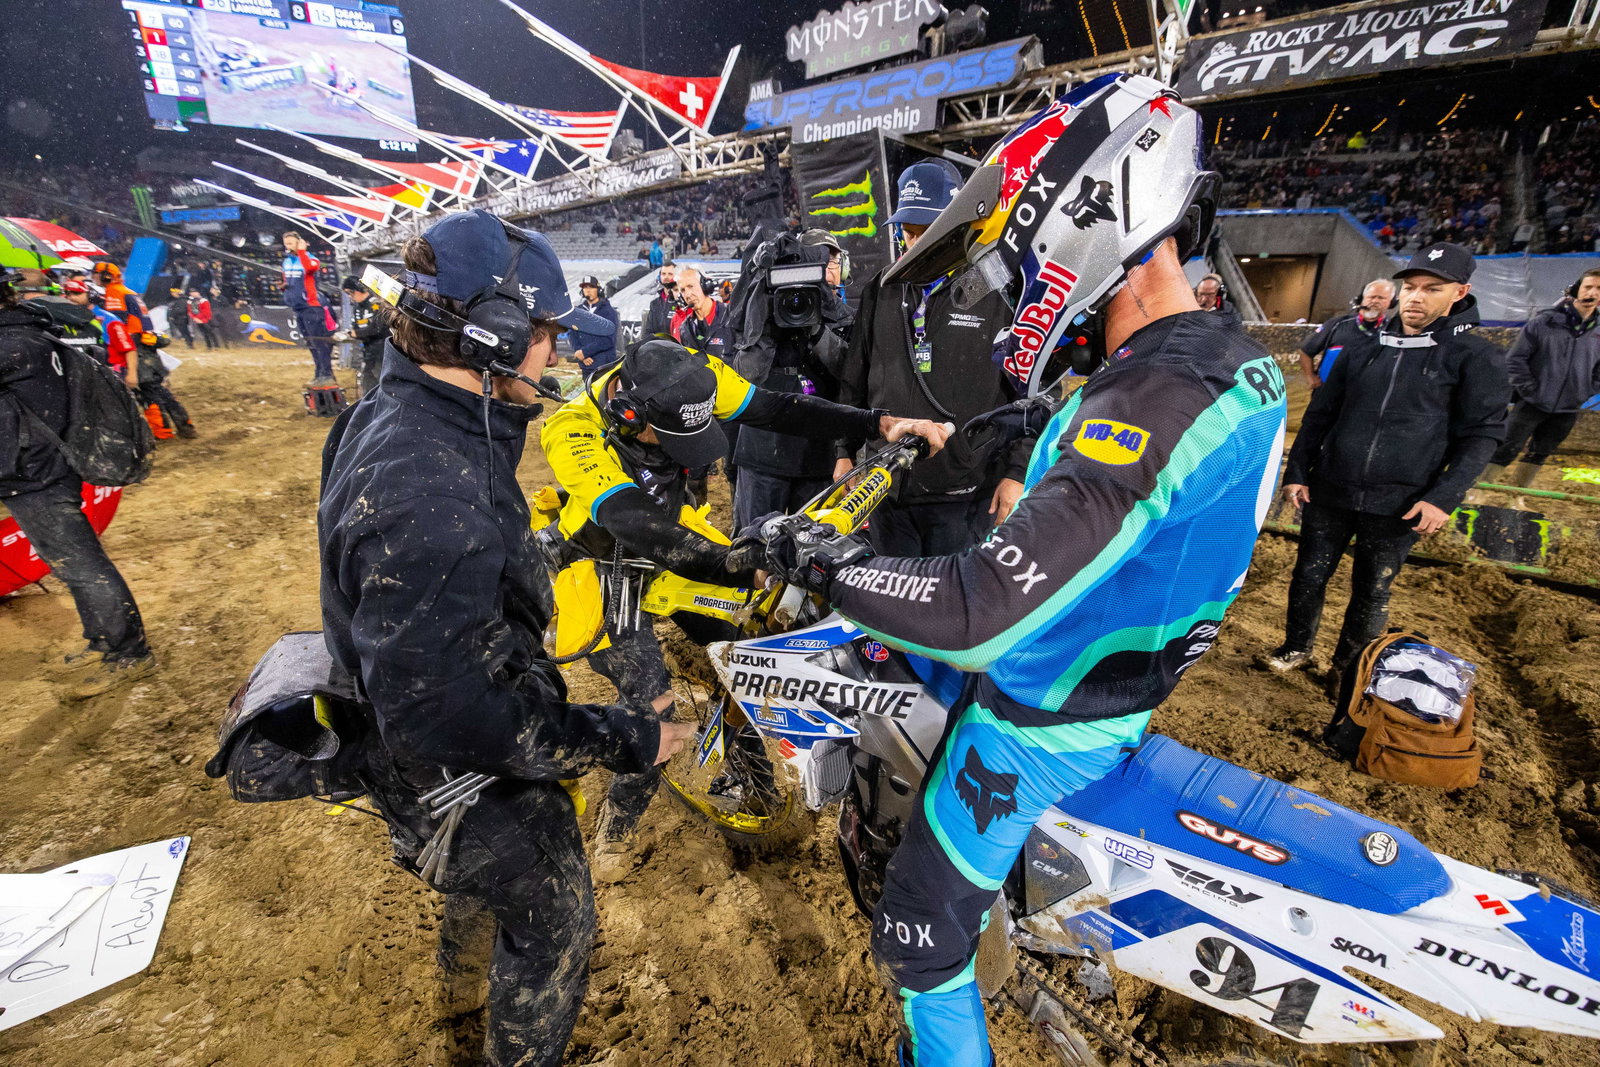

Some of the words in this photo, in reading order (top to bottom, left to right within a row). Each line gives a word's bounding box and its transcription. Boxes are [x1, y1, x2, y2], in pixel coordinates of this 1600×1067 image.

[292, 5, 305, 21] 8
[337, 18, 376, 32] WILSON
[393, 19, 404, 34] 9
[132, 28, 142, 39] 2
[136, 45, 146, 57] 3
[809, 34, 910, 73] ENERGY
[144, 79, 154, 91] 5
[742, 43, 1022, 132] SUPERCROSS
[751, 83, 773, 102] AMA
[803, 105, 921, 143] Championship
[1004, 173, 1057, 253] FOX
[948, 320, 982, 328] PROGRESSIVE
[1083, 423, 1143, 452] WD-40
[981, 535, 1048, 595] FOX
[785, 639, 830, 648] ECSTAR
[731, 671, 918, 719] PROGRESSIVE
[1104, 836, 1155, 870] WPS
[1179, 813, 1286, 862] GUTS
[1165, 858, 1265, 904] FLY
[1181, 881, 1238, 908] RACING
[883, 912, 935, 948] FOX
[1330, 936, 1388, 969] SKDA
[1190, 936, 1321, 1040] 94
[1343, 1000, 1375, 1019] AMA
